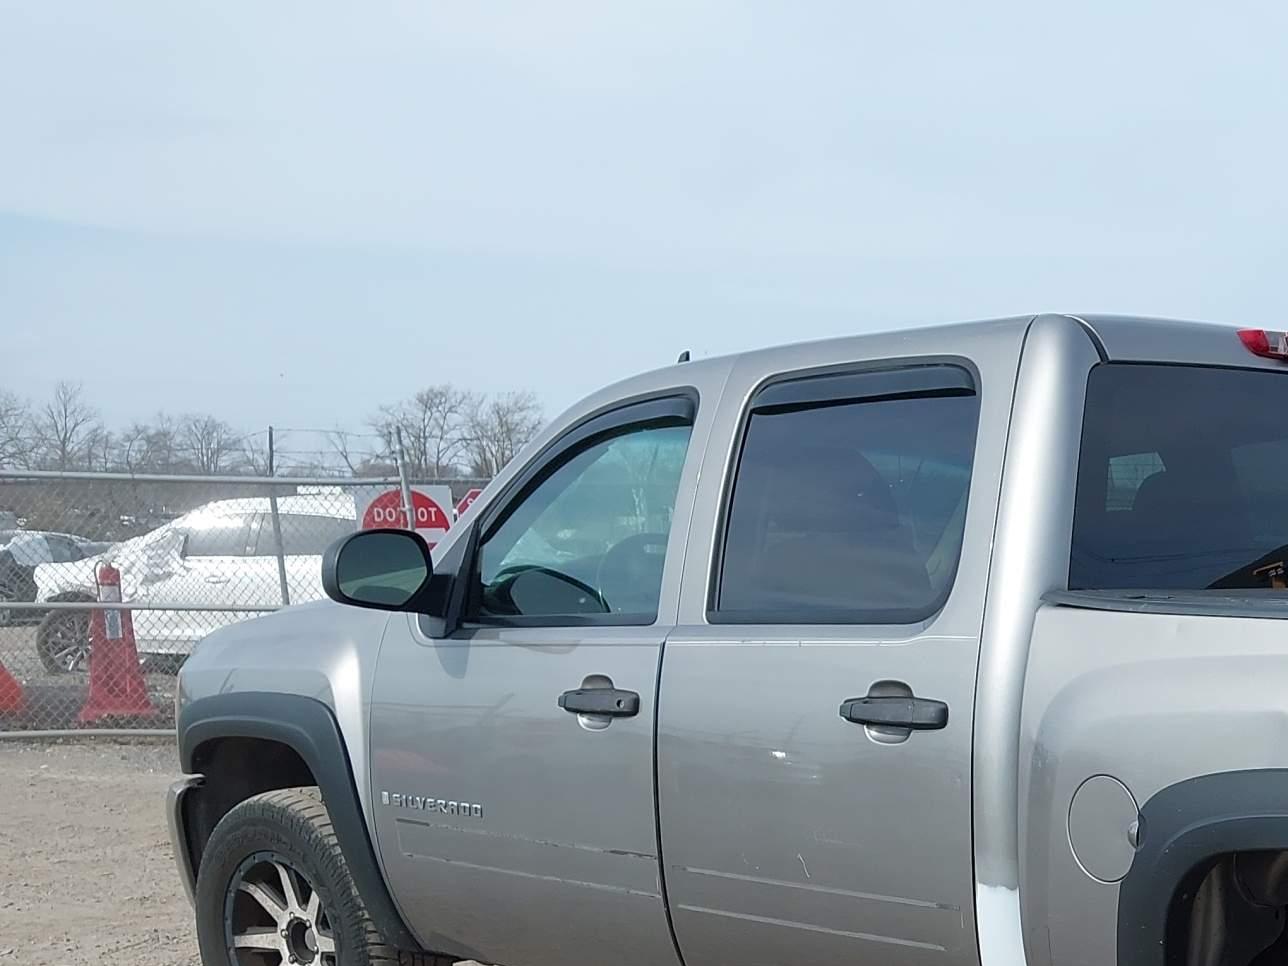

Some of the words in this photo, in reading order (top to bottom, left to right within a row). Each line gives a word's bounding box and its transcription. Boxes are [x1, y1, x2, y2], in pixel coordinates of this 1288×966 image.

[373, 507, 396, 522] DO
[397, 507, 438, 522] OT
[392, 793, 484, 818] SILVERADO
